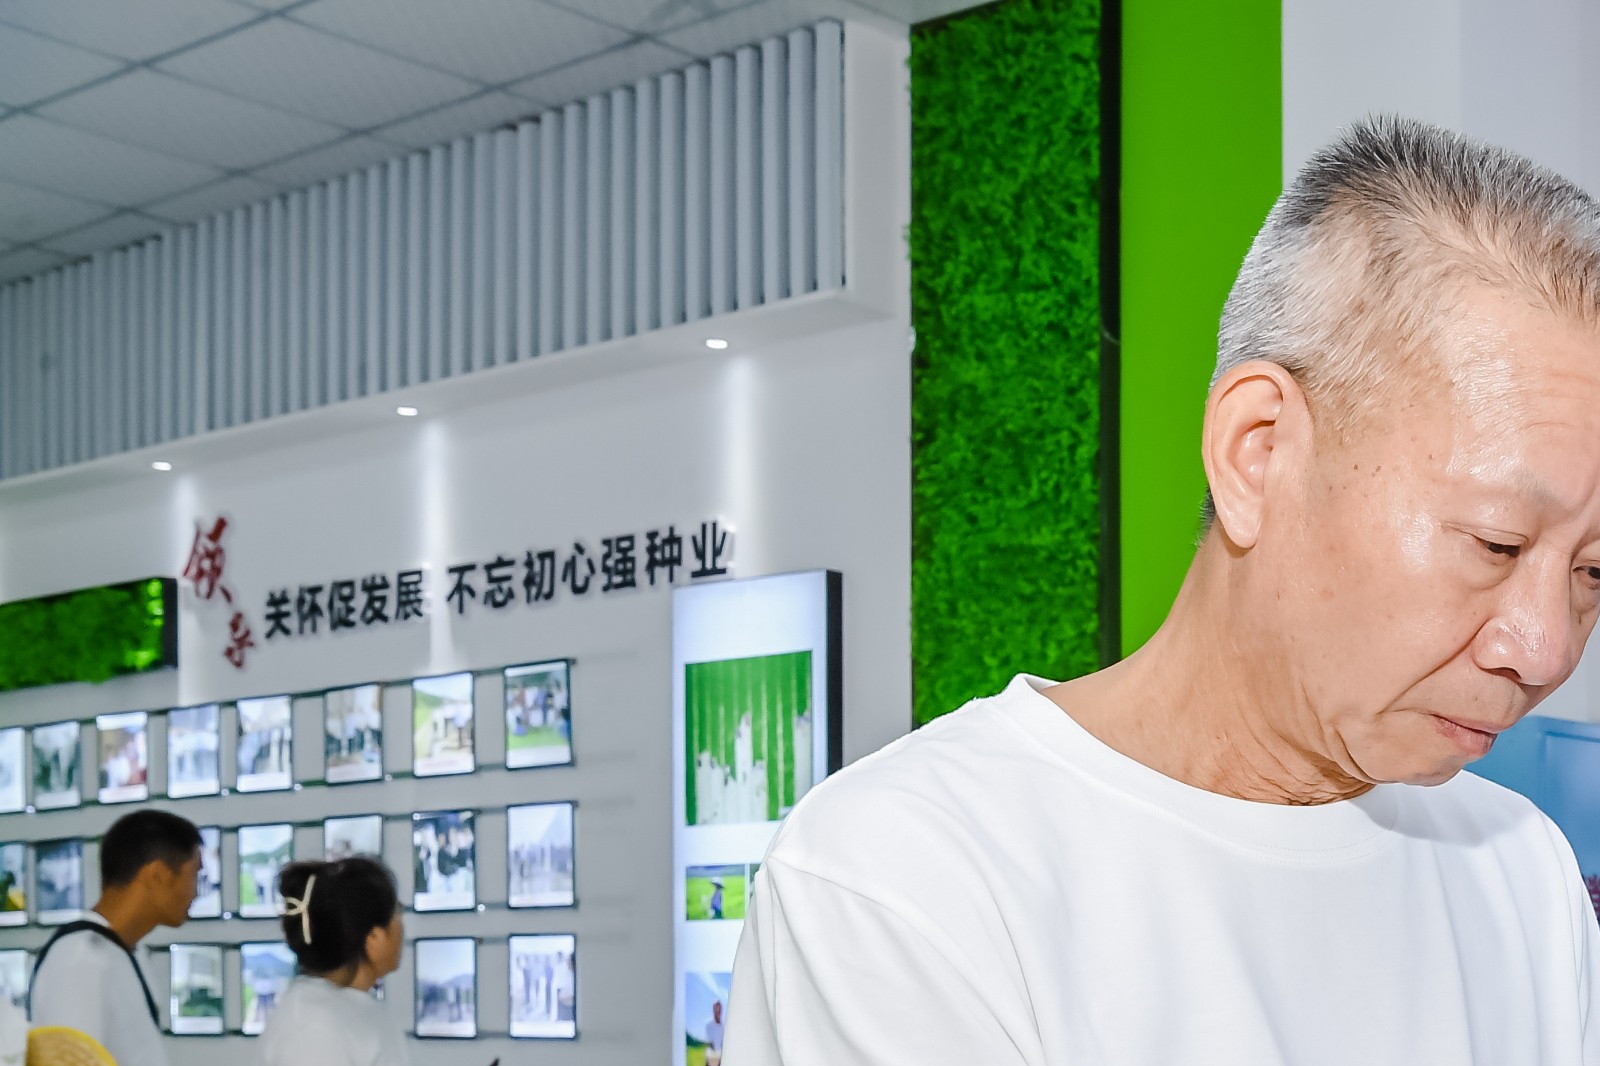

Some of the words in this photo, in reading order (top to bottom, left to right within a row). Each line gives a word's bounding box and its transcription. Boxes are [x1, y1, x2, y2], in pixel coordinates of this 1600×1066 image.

[265, 570, 424, 639] 关怀促发展
[446, 520, 727, 614] 不忘初心强种业
